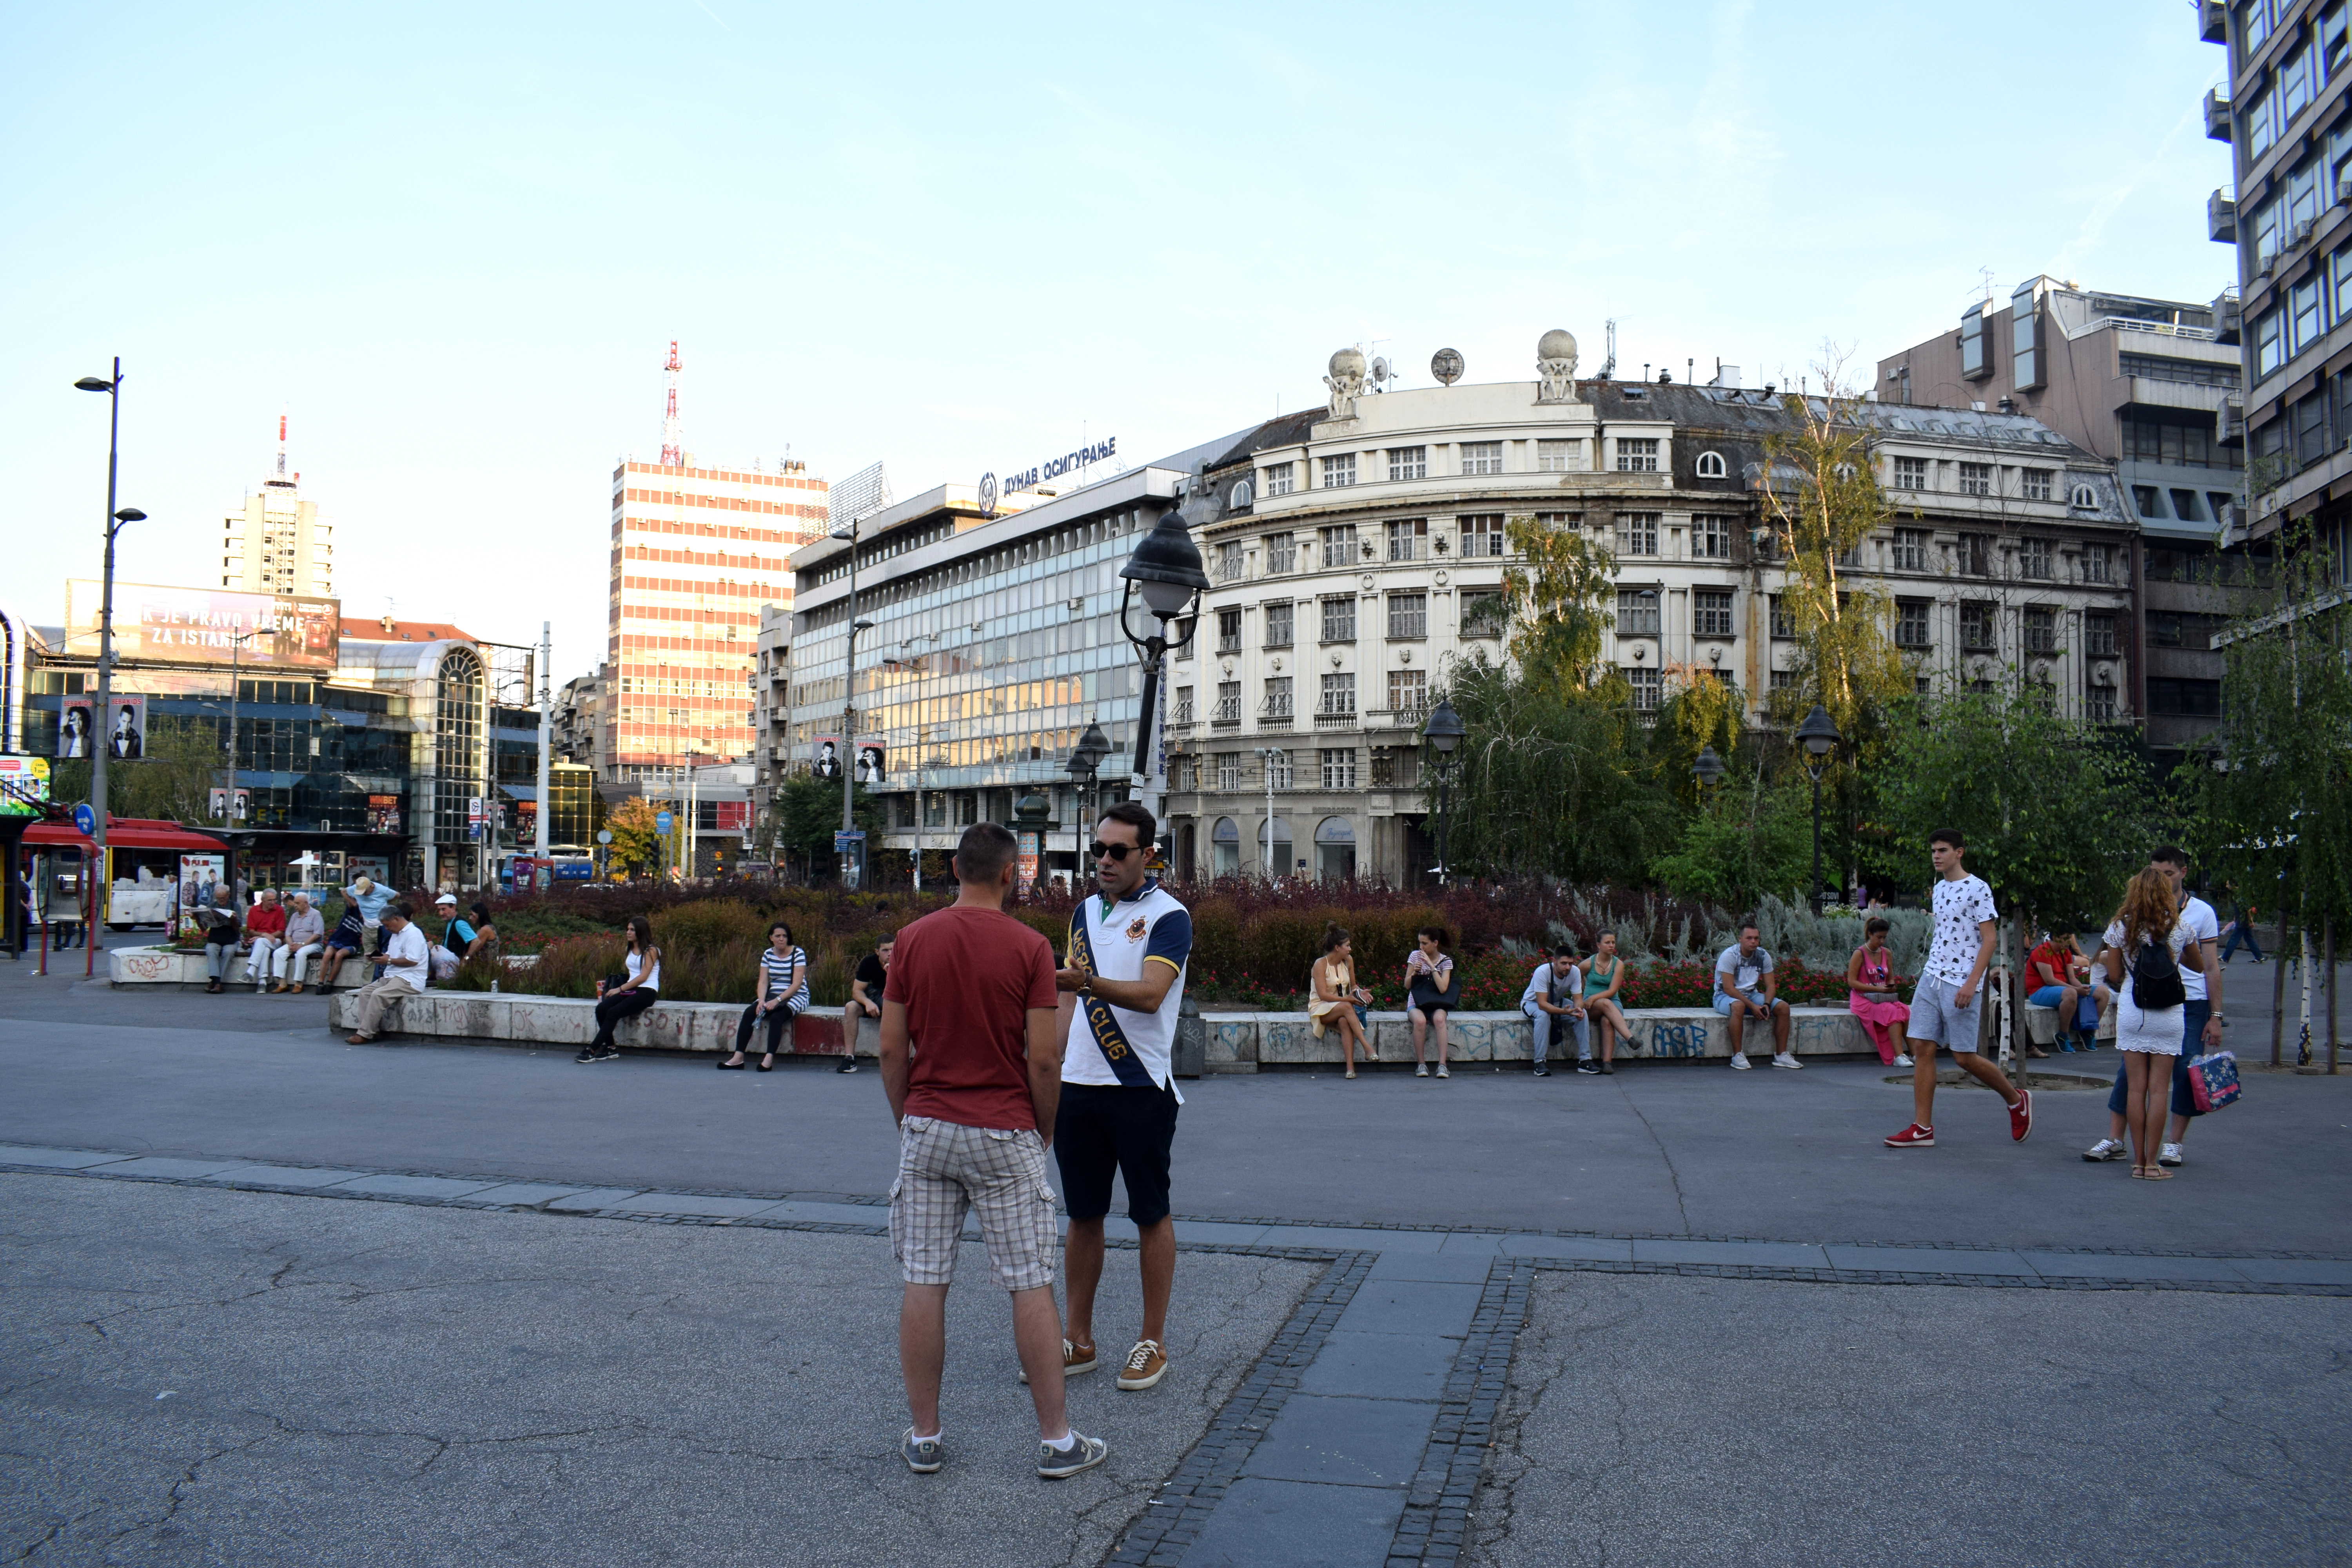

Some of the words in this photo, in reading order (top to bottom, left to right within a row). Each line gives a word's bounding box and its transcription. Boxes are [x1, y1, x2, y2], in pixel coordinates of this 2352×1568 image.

[1004, 467, 1038, 498] ДУНАВ
[1044, 436, 1116, 480] ОСИГУРАЊЕ
[161, 608, 180, 624] JE
[189, 609, 242, 628] PRAVO
[251, 614, 304, 632] VREME
[152, 627, 172, 644] ZA
[369, 795, 397, 804] WINBET
[1091, 1007, 1127, 1060] CLUB
